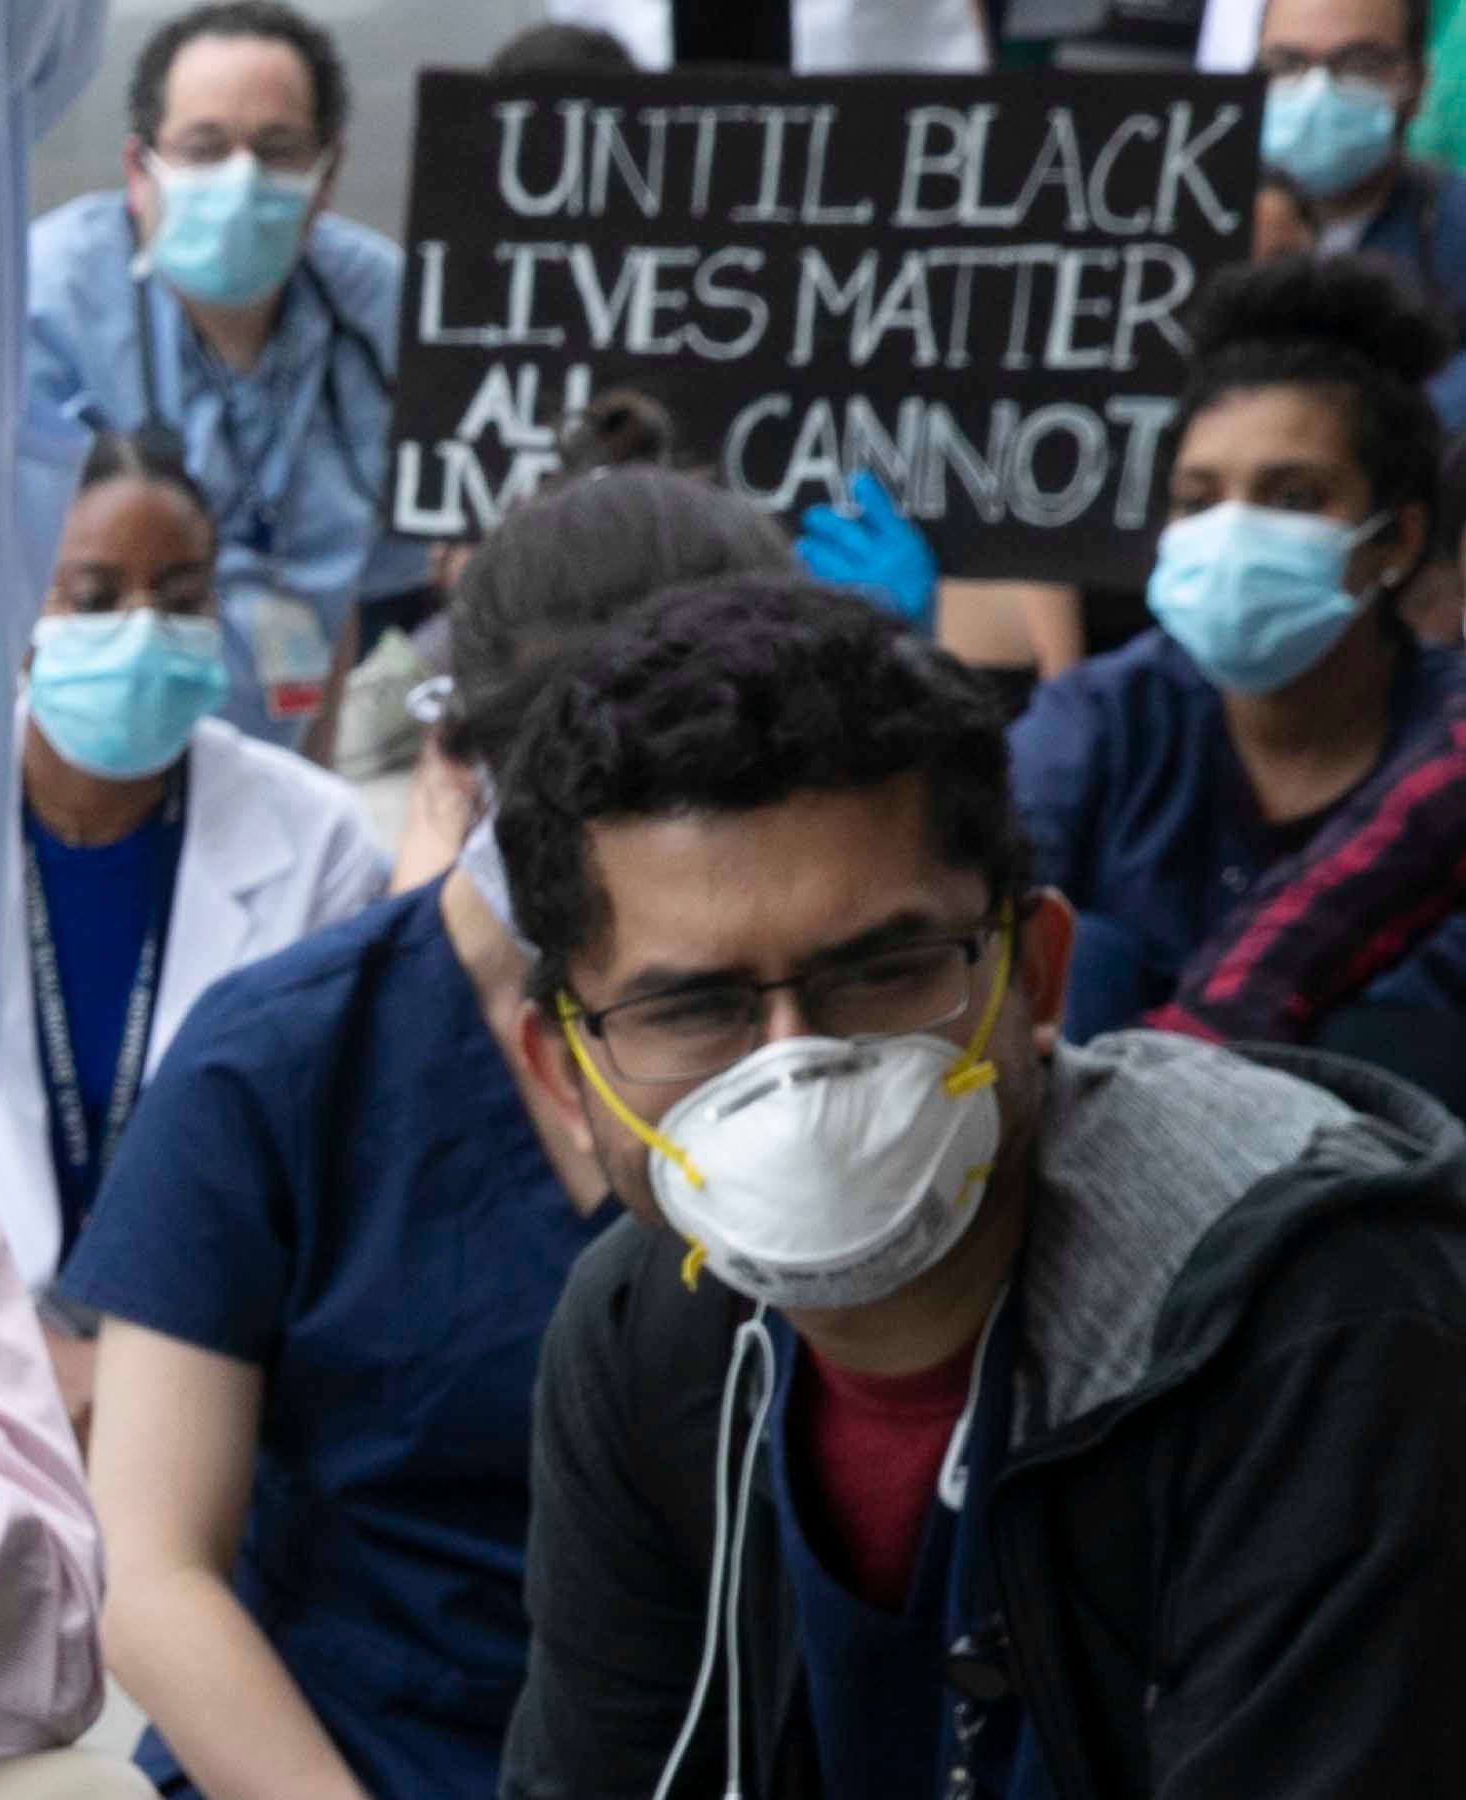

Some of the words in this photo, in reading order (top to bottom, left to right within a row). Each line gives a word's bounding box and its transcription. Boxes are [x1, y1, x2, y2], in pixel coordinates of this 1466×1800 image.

[493, 98, 873, 227] UNTIL
[889, 98, 1246, 236] BLACK
[416, 239, 773, 360] LIVES
[787, 242, 1199, 370] MATTER
[721, 394, 1183, 529] CANNOT
